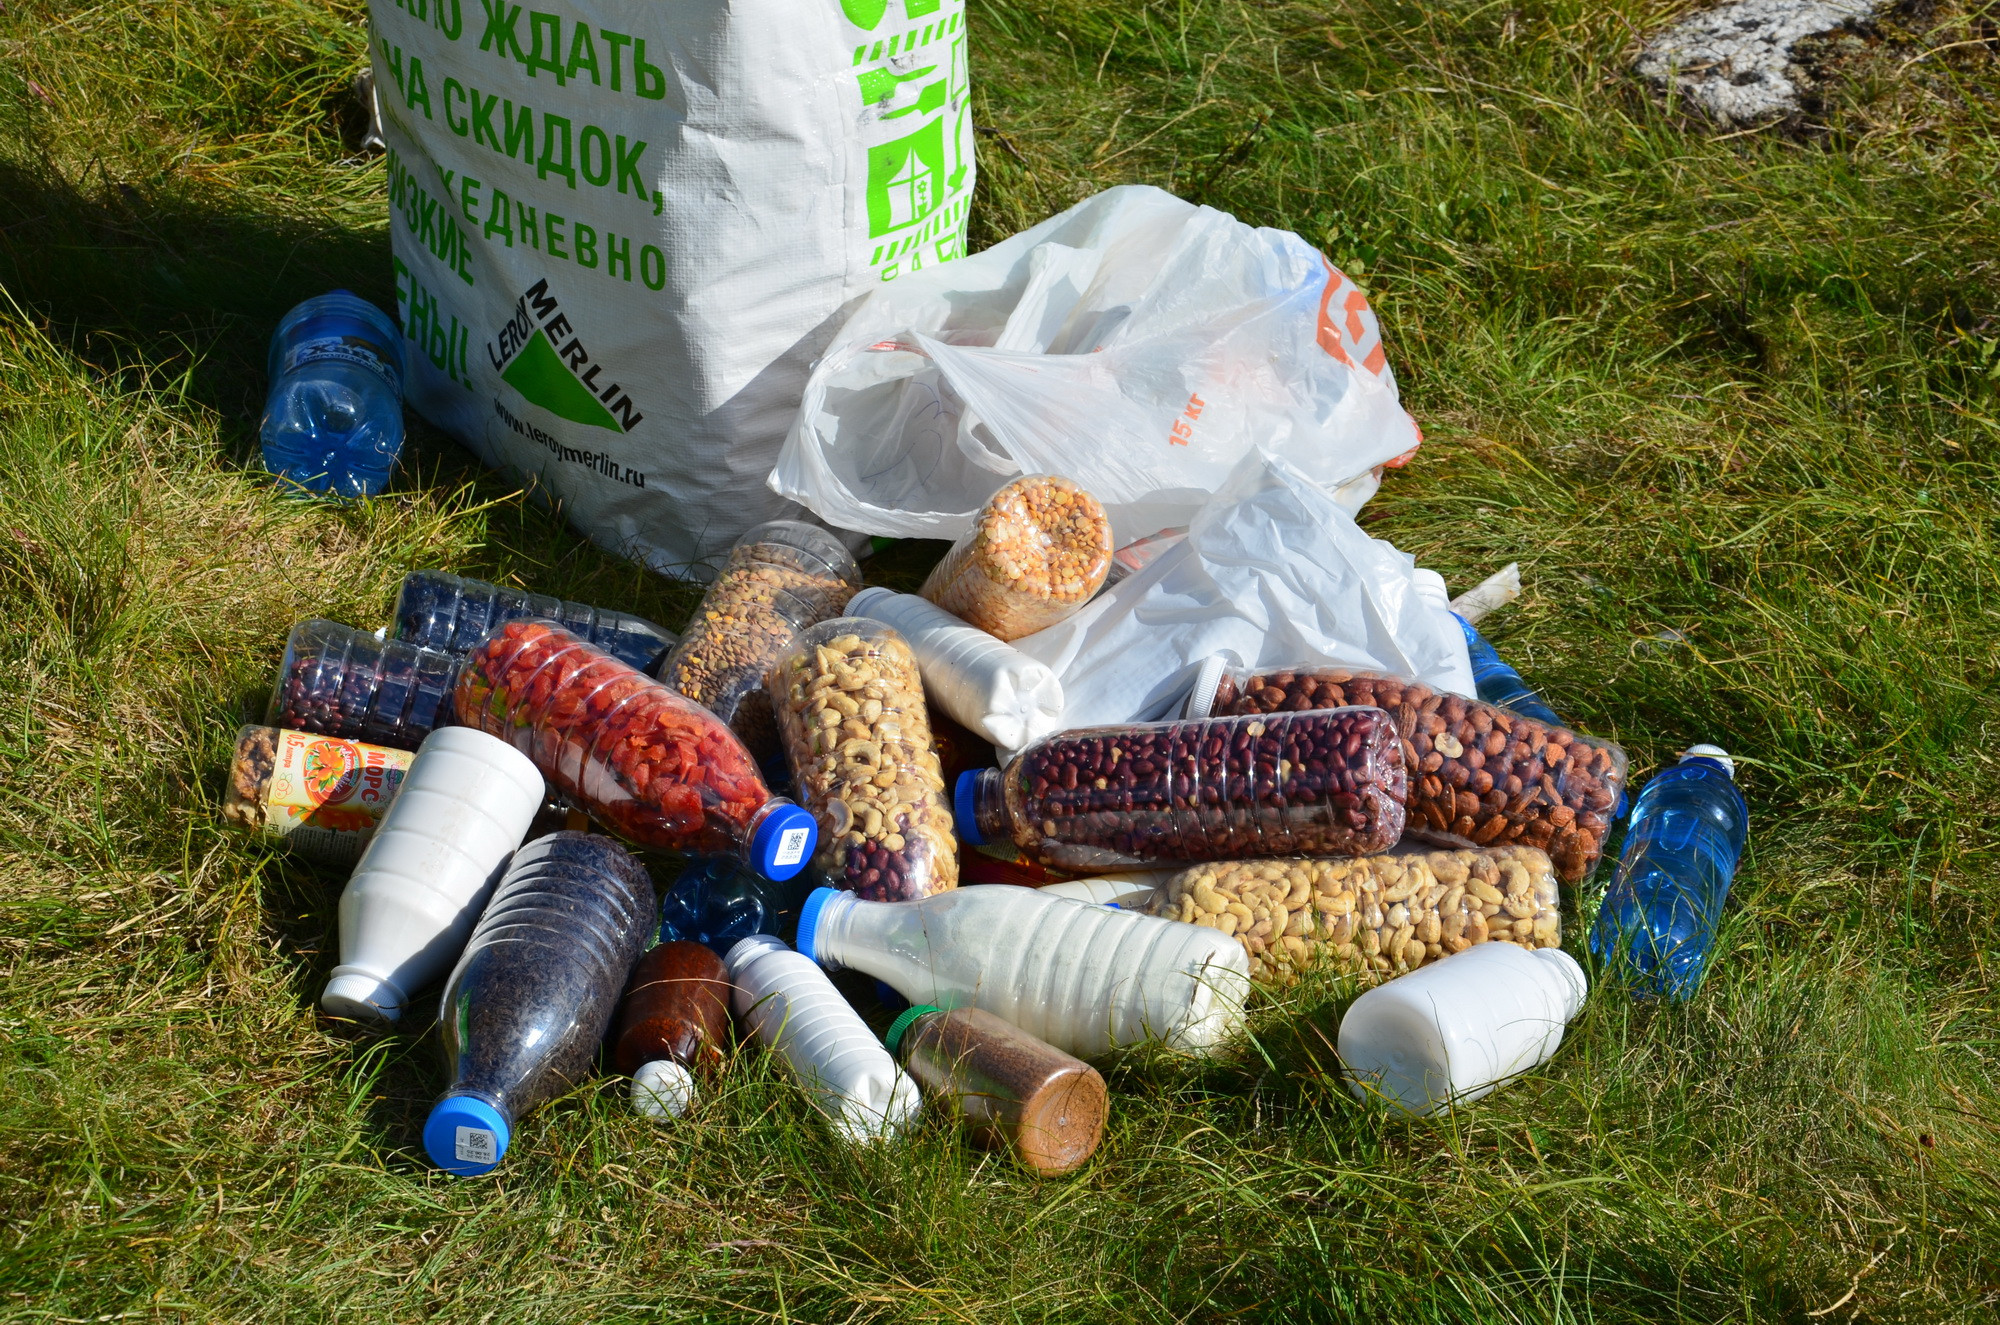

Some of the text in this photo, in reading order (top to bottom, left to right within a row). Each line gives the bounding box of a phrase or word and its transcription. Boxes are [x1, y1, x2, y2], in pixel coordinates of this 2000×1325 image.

[479, 0, 667, 101] ЖДАТЬ
[443, 76, 665, 217] СКИДОК,
[487, 295, 534, 373] LEROY
[525, 277, 644, 433] MERLIN
[493, 396, 645, 489] www.leroymerlin.ru
[1168, 419, 1193, 446] 15
[286, 733, 306, 749] 0,5
[361, 750, 387, 804] МОРС
